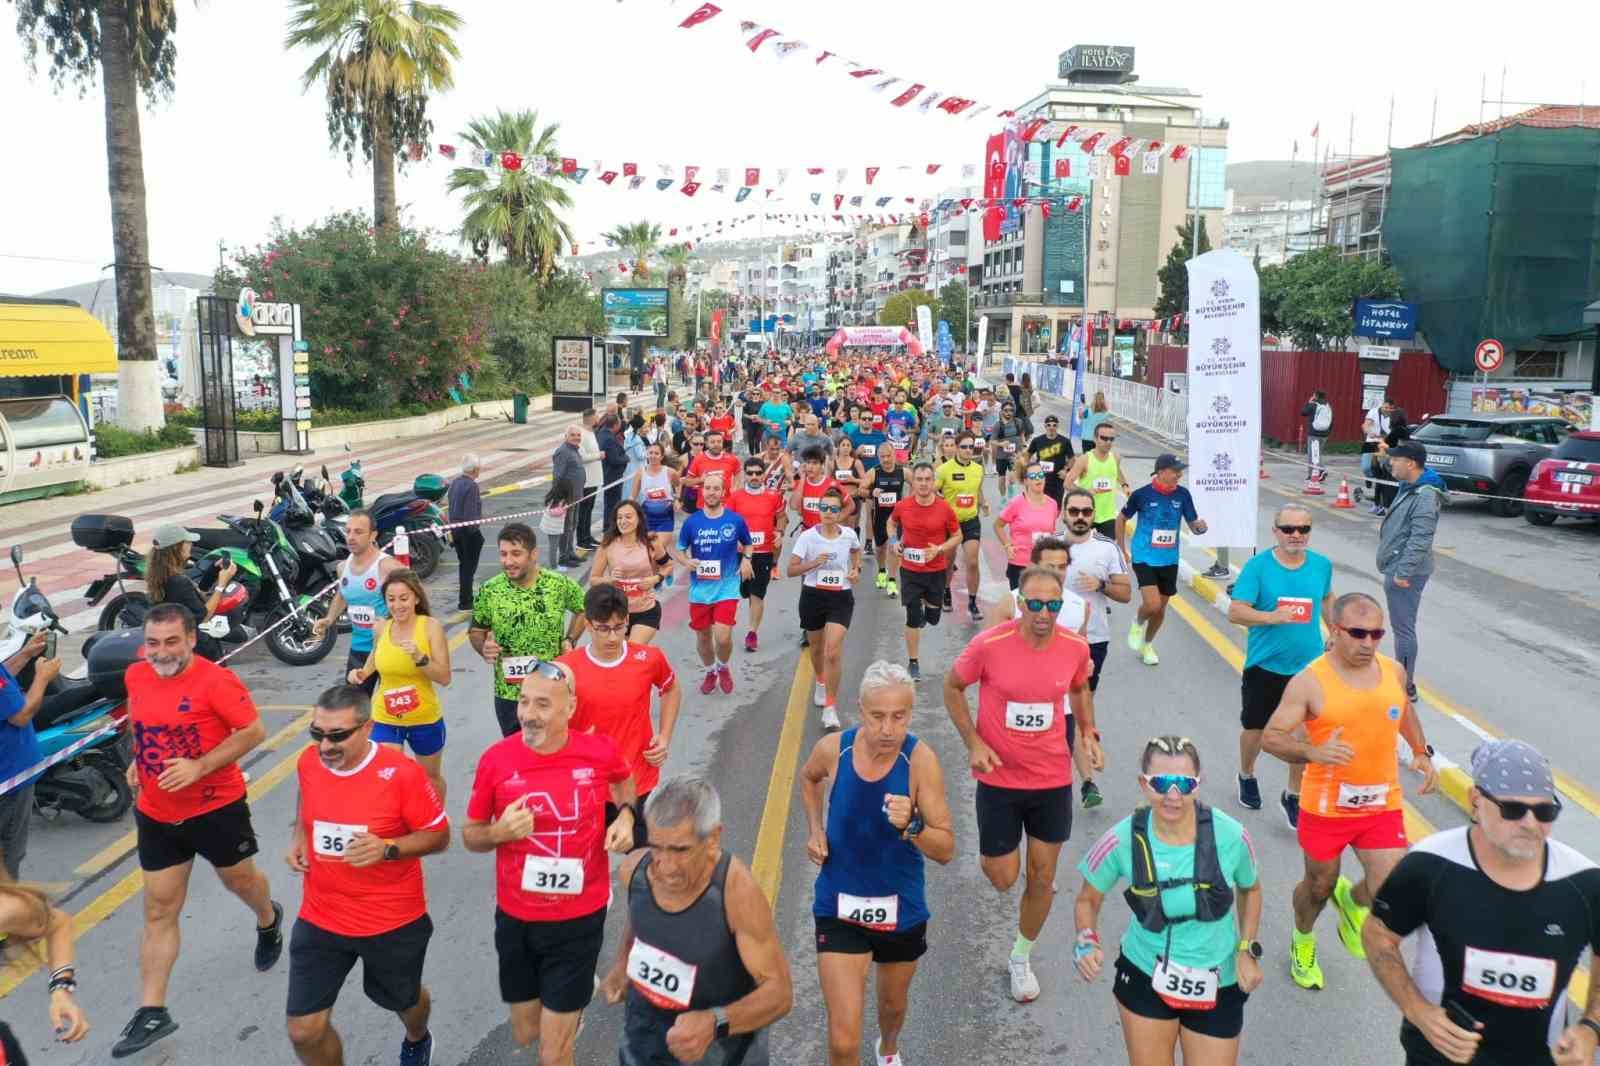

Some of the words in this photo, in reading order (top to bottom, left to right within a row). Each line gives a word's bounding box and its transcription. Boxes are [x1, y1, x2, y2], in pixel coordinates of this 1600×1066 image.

[822, 576, 840, 584] 493
[389, 694, 412, 707] 243
[1015, 714, 1045, 727] 525
[535, 871, 570, 889] 312
[849, 908, 887, 923] 469
[637, 961, 680, 993] 320
[1165, 973, 1207, 996] 355
[1480, 969, 1537, 993] 508
